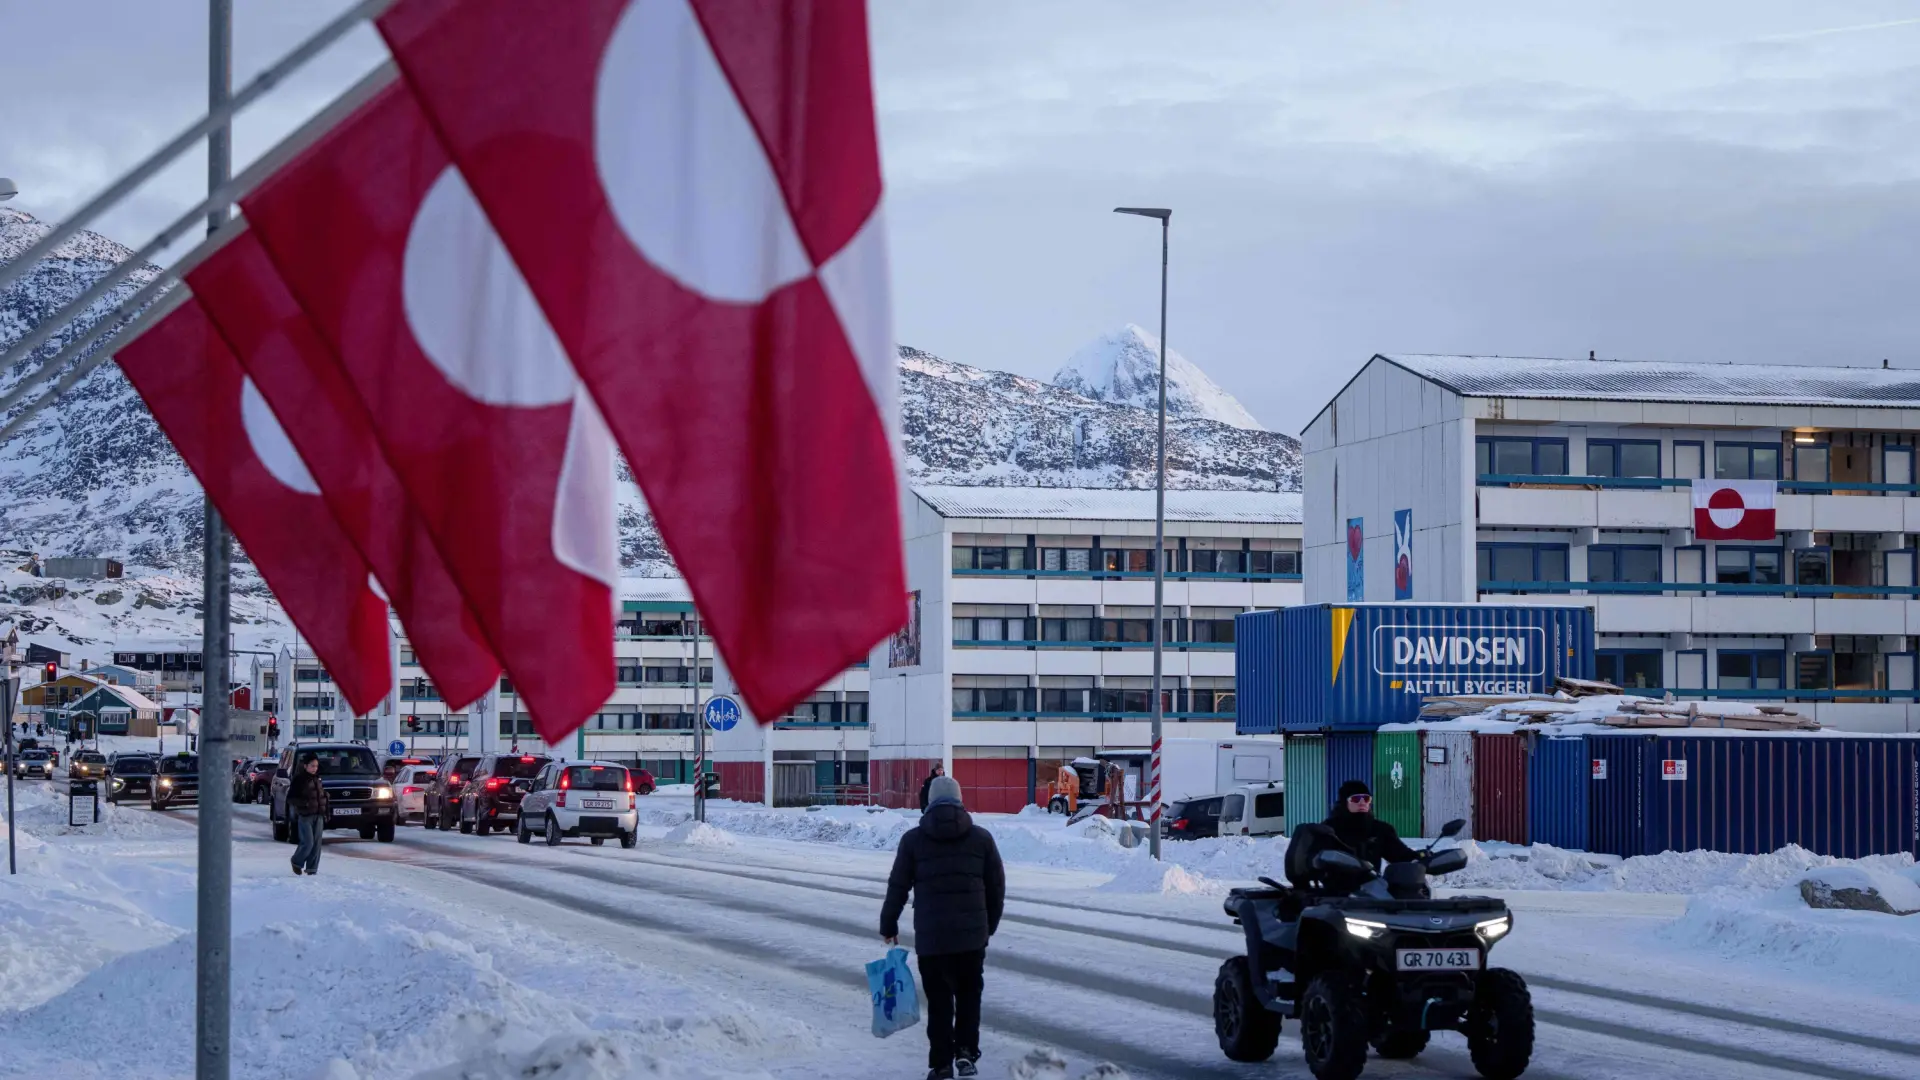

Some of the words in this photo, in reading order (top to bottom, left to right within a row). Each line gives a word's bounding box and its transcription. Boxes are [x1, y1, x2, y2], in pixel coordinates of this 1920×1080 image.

[1394, 636, 1526, 666] DAVIDSEN
[1404, 680, 1433, 694] ALT
[1435, 680, 1460, 694] TIL
[1464, 680, 1531, 694] BYGGERI
[1403, 952, 1422, 967] GR
[1426, 952, 1443, 967] 70
[1446, 951, 1472, 967] 431
